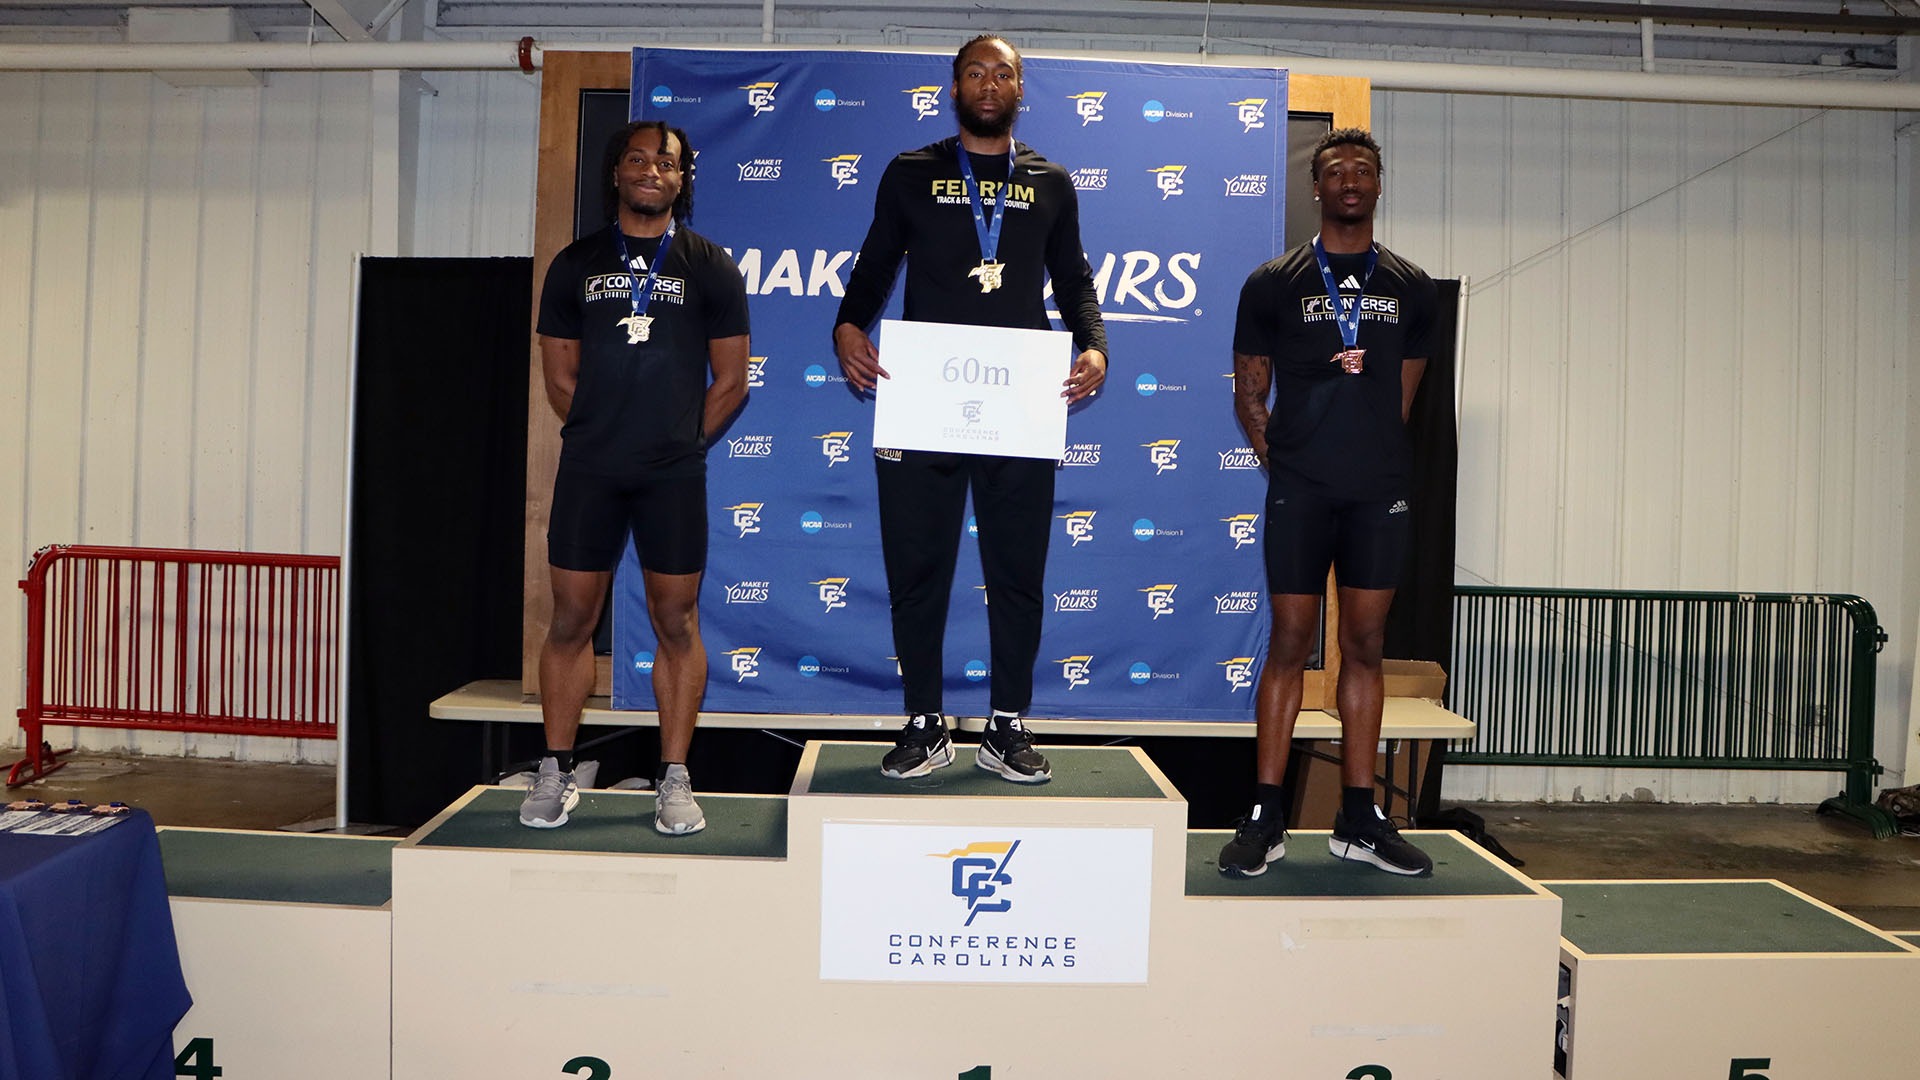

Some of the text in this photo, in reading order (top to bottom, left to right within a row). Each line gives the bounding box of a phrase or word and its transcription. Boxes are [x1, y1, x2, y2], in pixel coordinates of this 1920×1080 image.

[674, 96, 696, 104] Division
[1144, 110, 1165, 118] NCAA
[1166, 111, 1188, 119] Division
[738, 161, 782, 181] YOURS
[1224, 177, 1267, 196] YOURS
[937, 196, 956, 204] TRACK
[983, 198, 997, 206] CRO
[1004, 199, 1030, 210] COUNTRY
[723, 248, 860, 297] MAK
[586, 291, 602, 303] CROSS
[604, 291, 630, 299] COUNTRY
[667, 296, 684, 305] FIELD
[1303, 313, 1322, 323] CROSS
[1384, 315, 1398, 324] FIELD
[806, 374, 826, 382] NCAA
[943, 357, 1010, 386] 60m
[728, 438, 772, 457] YOURS
[1218, 449, 1261, 470] YOURS
[725, 584, 769, 603] YOURS
[1054, 592, 1098, 612] YOURS
[1215, 594, 1258, 614] YOURS
[889, 934, 1077, 950] CONFERENCE
[889, 952, 1077, 968] CAROLINAS
[175, 1037, 223, 1080] 4
